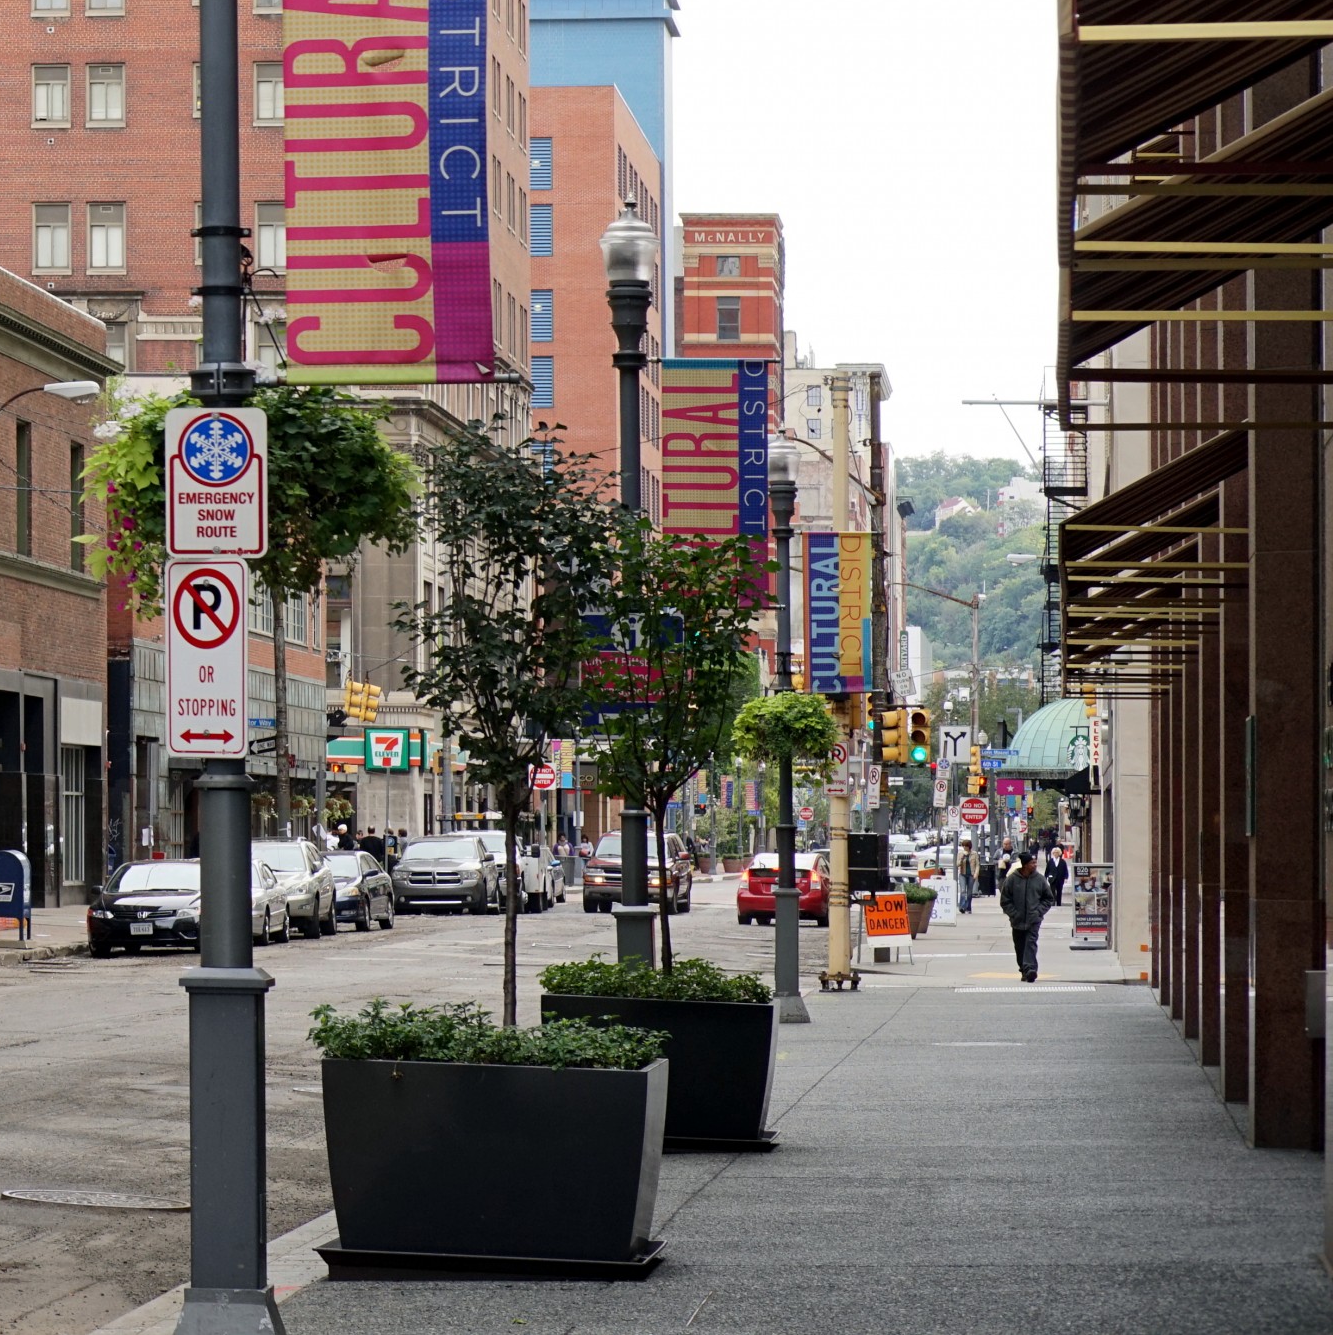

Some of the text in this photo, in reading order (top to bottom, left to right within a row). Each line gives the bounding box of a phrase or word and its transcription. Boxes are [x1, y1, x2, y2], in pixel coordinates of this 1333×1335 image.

[694, 232, 765, 243] McNALLY
[744, 359, 766, 531] DISTRICT
[662, 373, 739, 550] LTURAL
[178, 492, 255, 505] EMERGENCY
[197, 509, 236, 522] SNOW
[196, 525, 237, 539] ROUTE
[840, 535, 862, 675] DISTRICT
[811, 537, 842, 693] CULTURAL
[198, 665, 215, 683] OR
[178, 698, 237, 717] STOPPING
[259, 719, 272, 727] Way
[936, 897, 952, 905] ATE
[869, 918, 906, 930] DANGER
